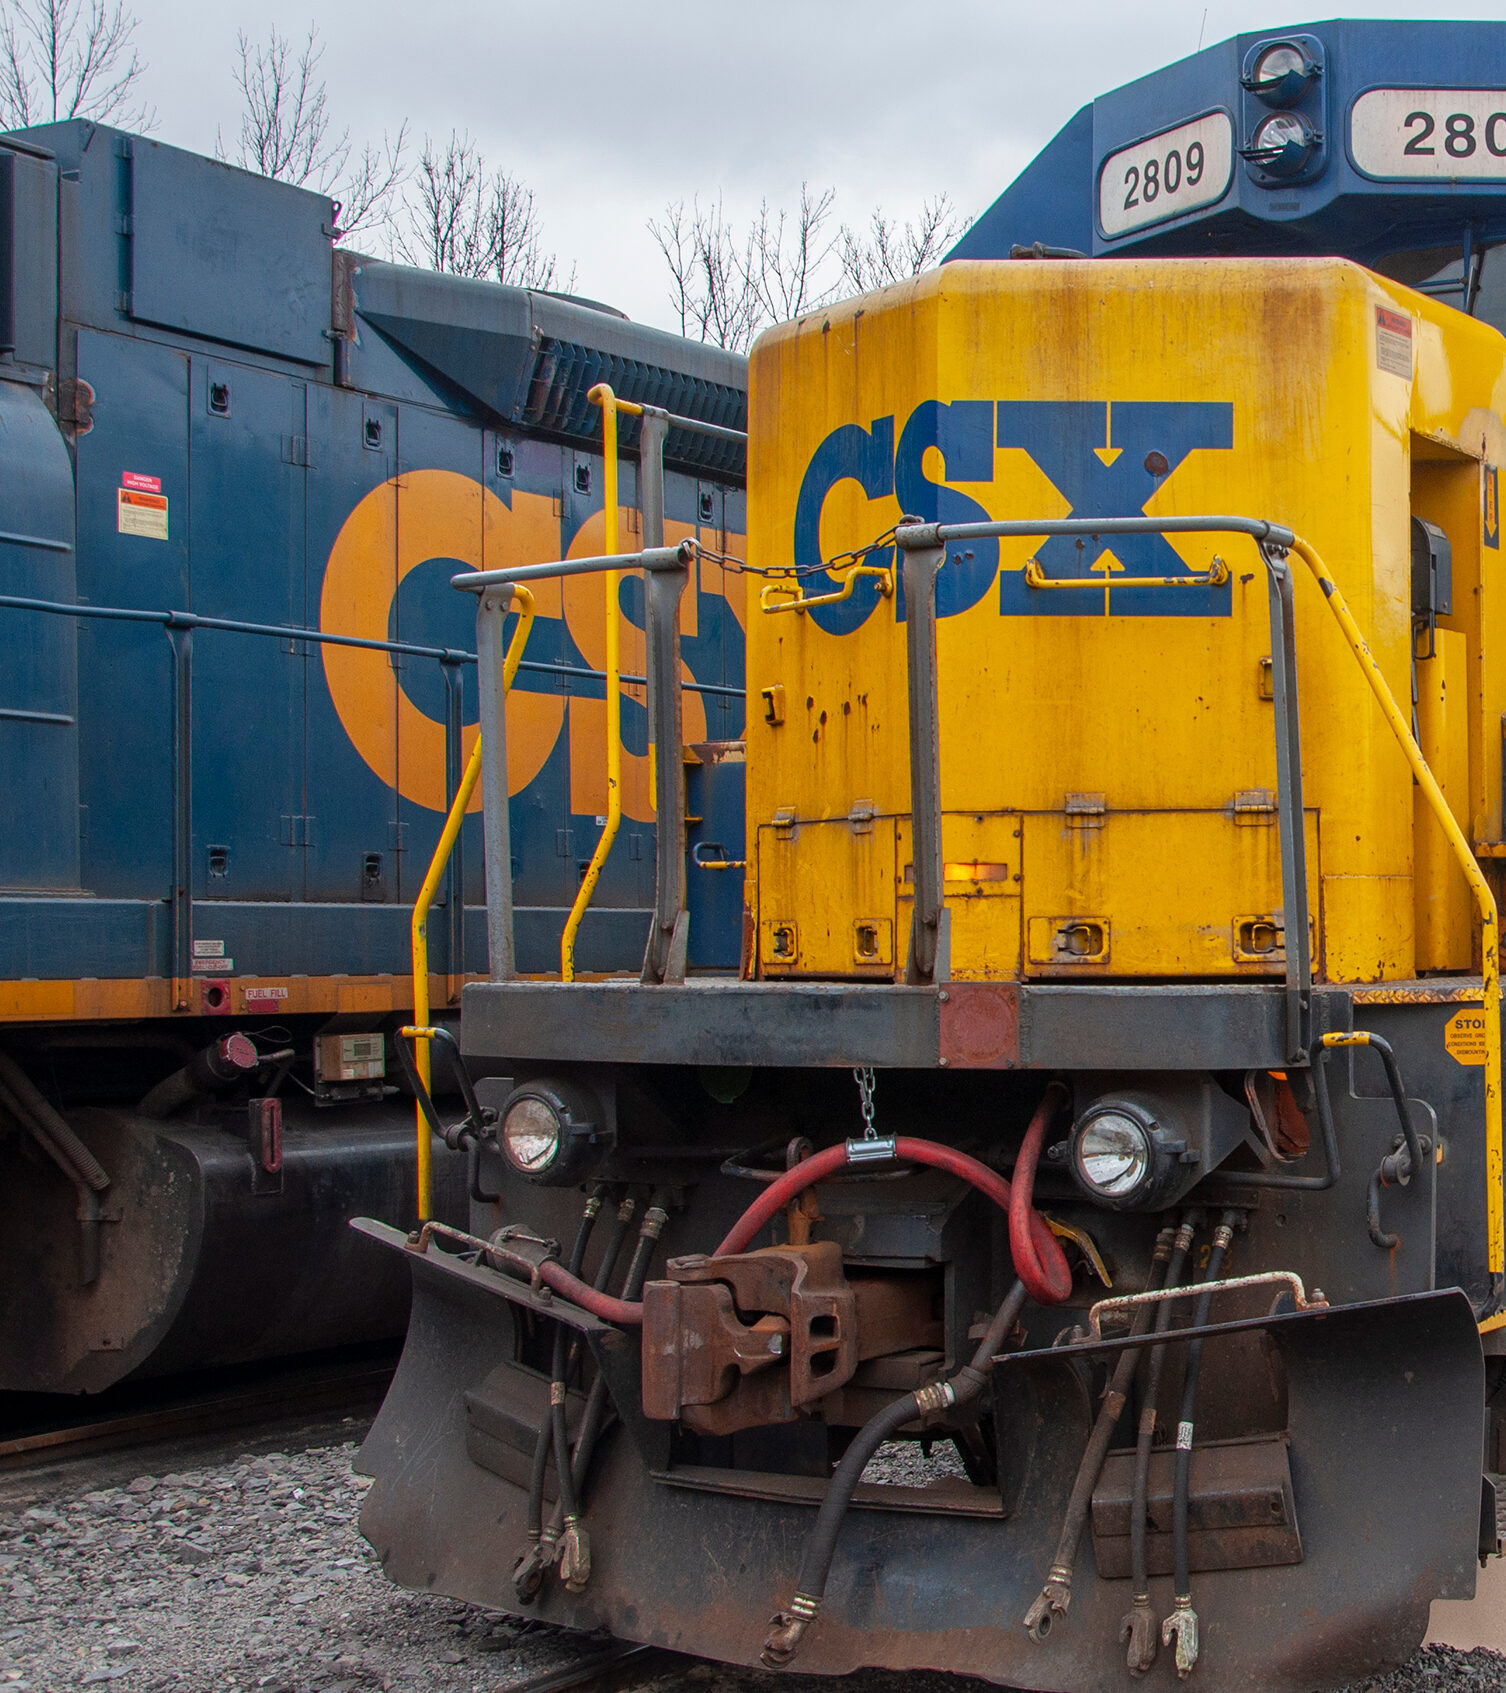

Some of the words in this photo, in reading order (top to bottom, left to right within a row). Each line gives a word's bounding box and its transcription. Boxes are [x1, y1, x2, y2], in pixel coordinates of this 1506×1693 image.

[1123, 141, 1205, 211] 2809
[793, 399, 1234, 637] CSX
[319, 468, 747, 824] CS
[248, 990, 266, 998] FUEL
[270, 989, 285, 997] FILL
